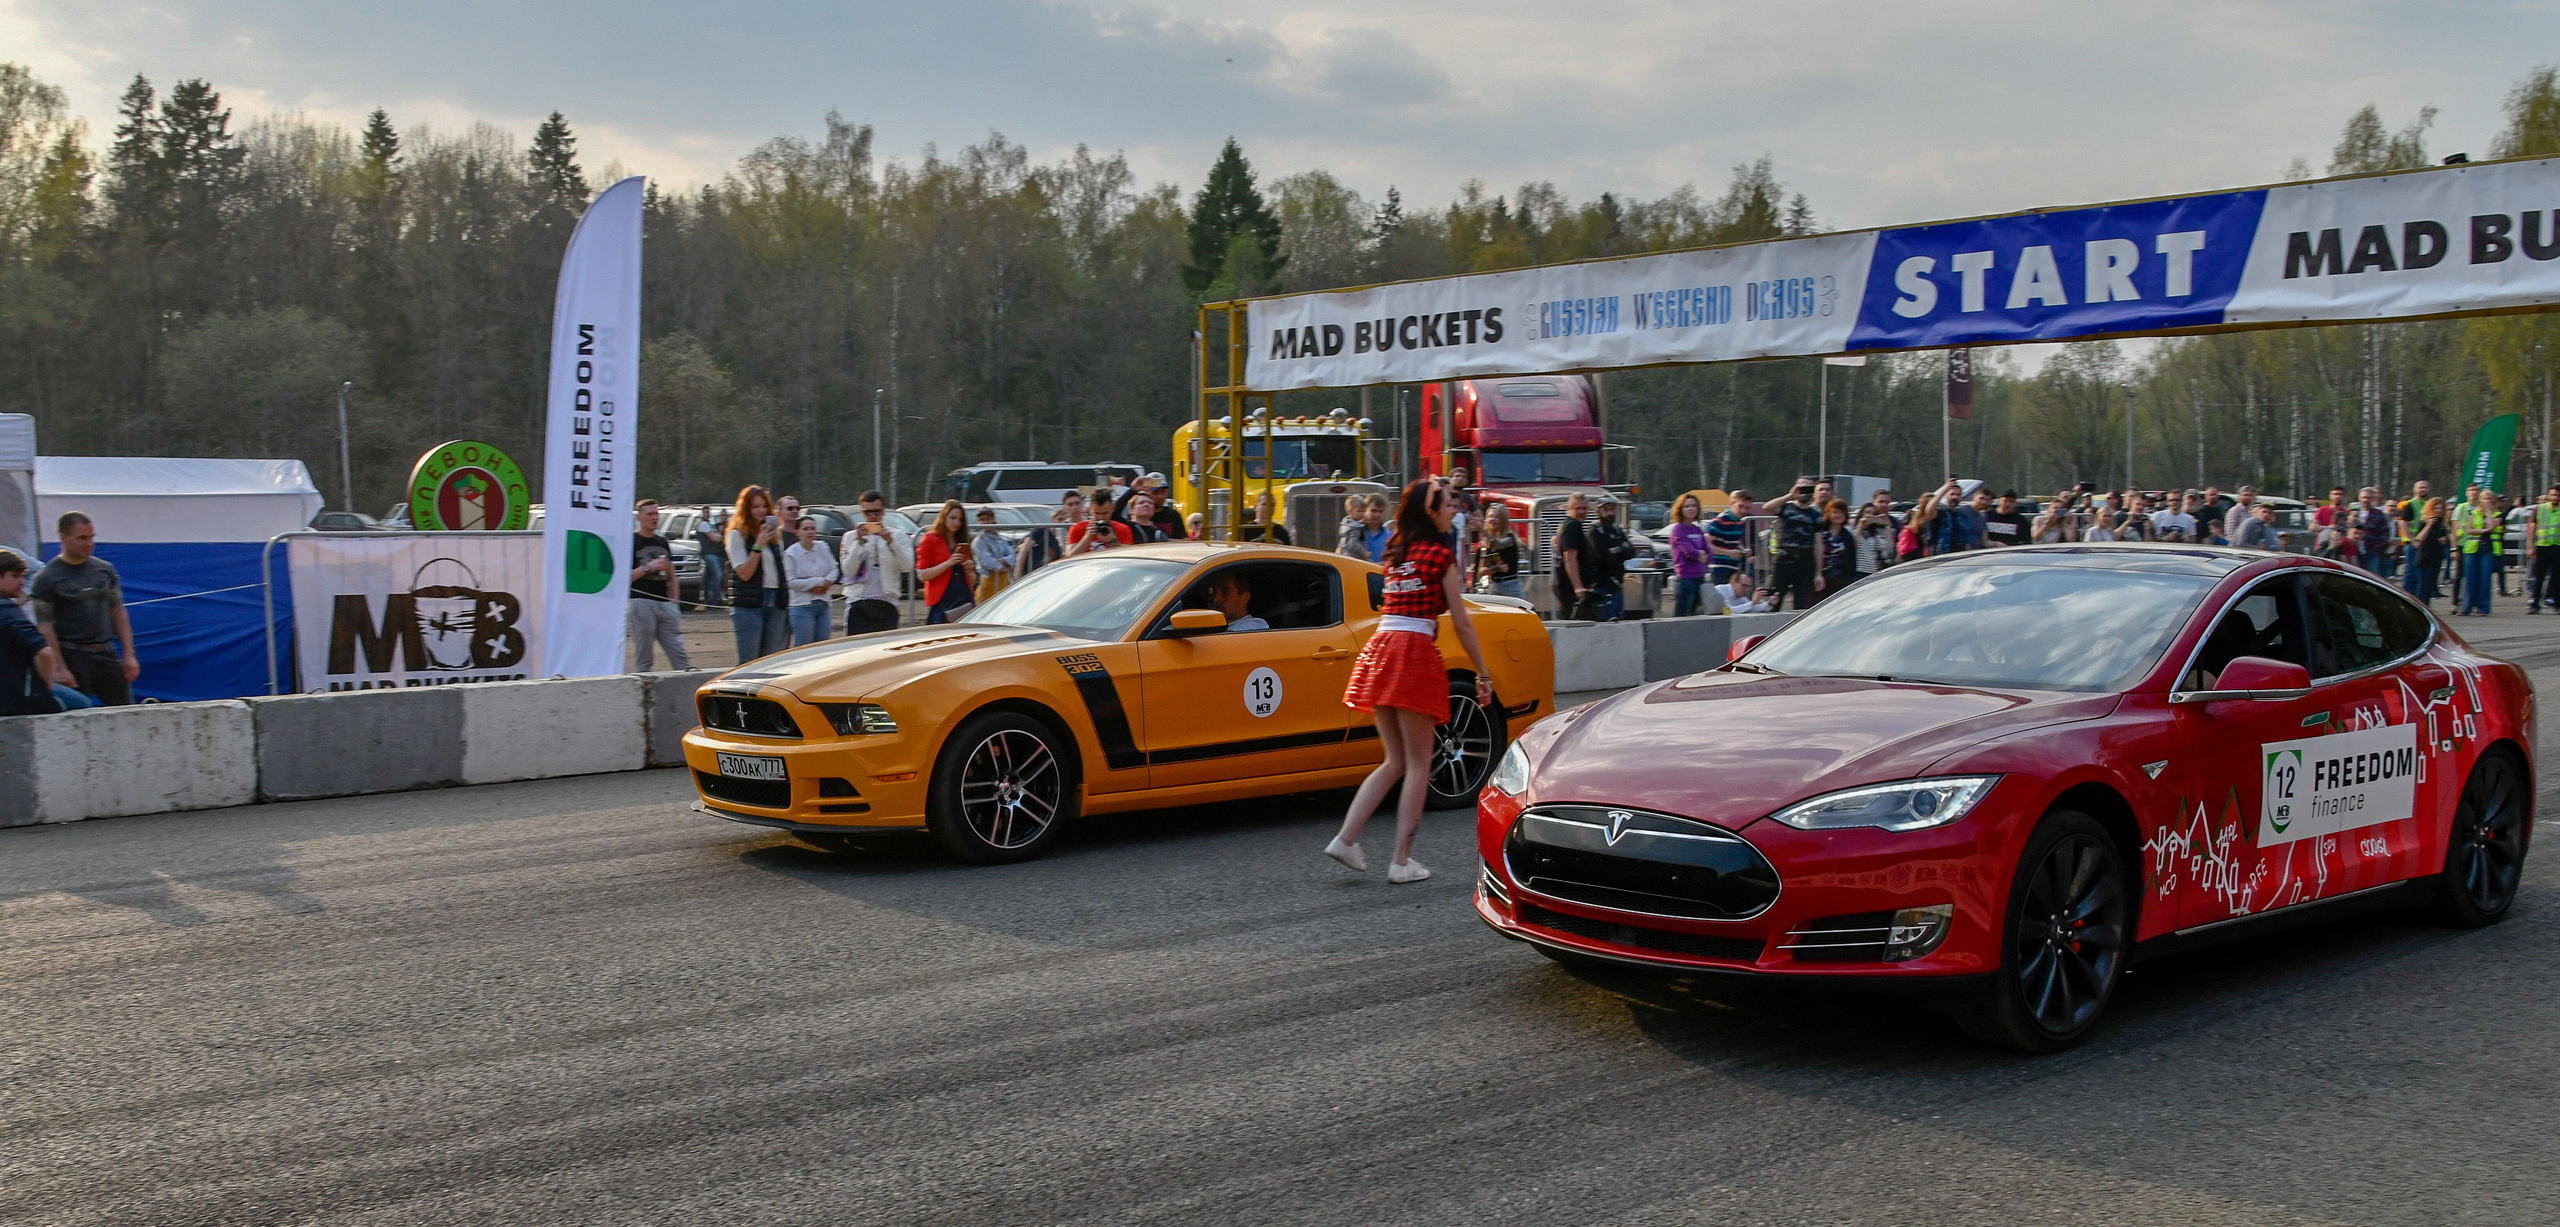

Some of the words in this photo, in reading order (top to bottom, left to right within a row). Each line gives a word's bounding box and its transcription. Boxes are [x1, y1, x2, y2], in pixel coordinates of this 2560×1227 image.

[2282, 220, 2448, 280] MAD
[1891, 230, 2206, 318] START
[1540, 295, 1620, 339] RUSSIAN
[1633, 285, 1732, 331] WEEKEND
[1746, 276, 1815, 322] DRAGS
[1269, 324, 1344, 361] MAD
[1354, 307, 1503, 354] BUCKETS
[570, 324, 596, 510] FREEDOM
[592, 400, 615, 512] finance
[2473, 451, 2491, 483] EDOM
[1055, 652, 1099, 665] BOSS
[1066, 662, 1104, 674] 302
[1251, 676, 1274, 700] 13
[761, 758, 780, 773] 777
[2276, 765, 2295, 799] 12
[2314, 747, 2413, 792] FREEDOM
[2312, 793, 2365, 819] finance
[2160, 874, 2177, 901] MCD
[2249, 857, 2268, 890] PFE
